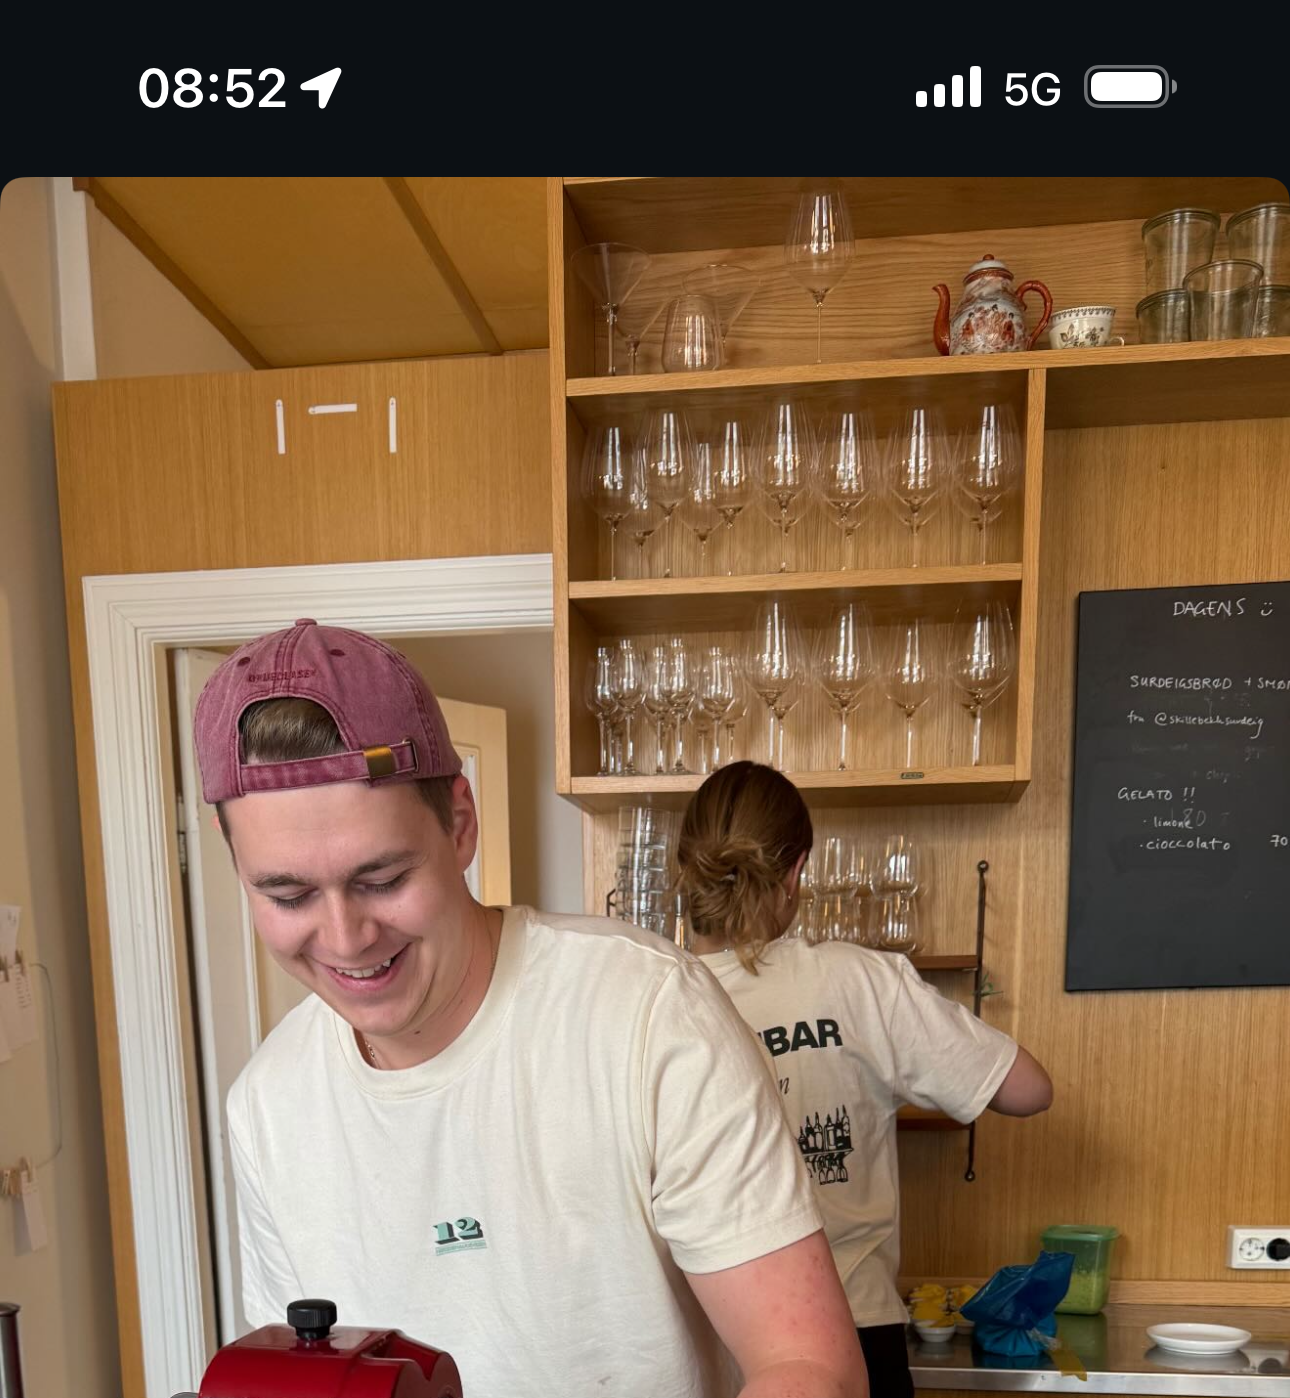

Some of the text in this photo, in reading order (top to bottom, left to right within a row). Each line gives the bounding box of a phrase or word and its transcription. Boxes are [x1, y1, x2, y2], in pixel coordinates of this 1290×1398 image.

[1172, 597, 1246, 617] DAGENS
[1117, 786, 1173, 801] GELATO
[1153, 814, 1194, 830] limone
[1146, 836, 1231, 851] cioccolato
[757, 1019, 843, 1057] BAR
[433, 1216, 483, 1245] 12
